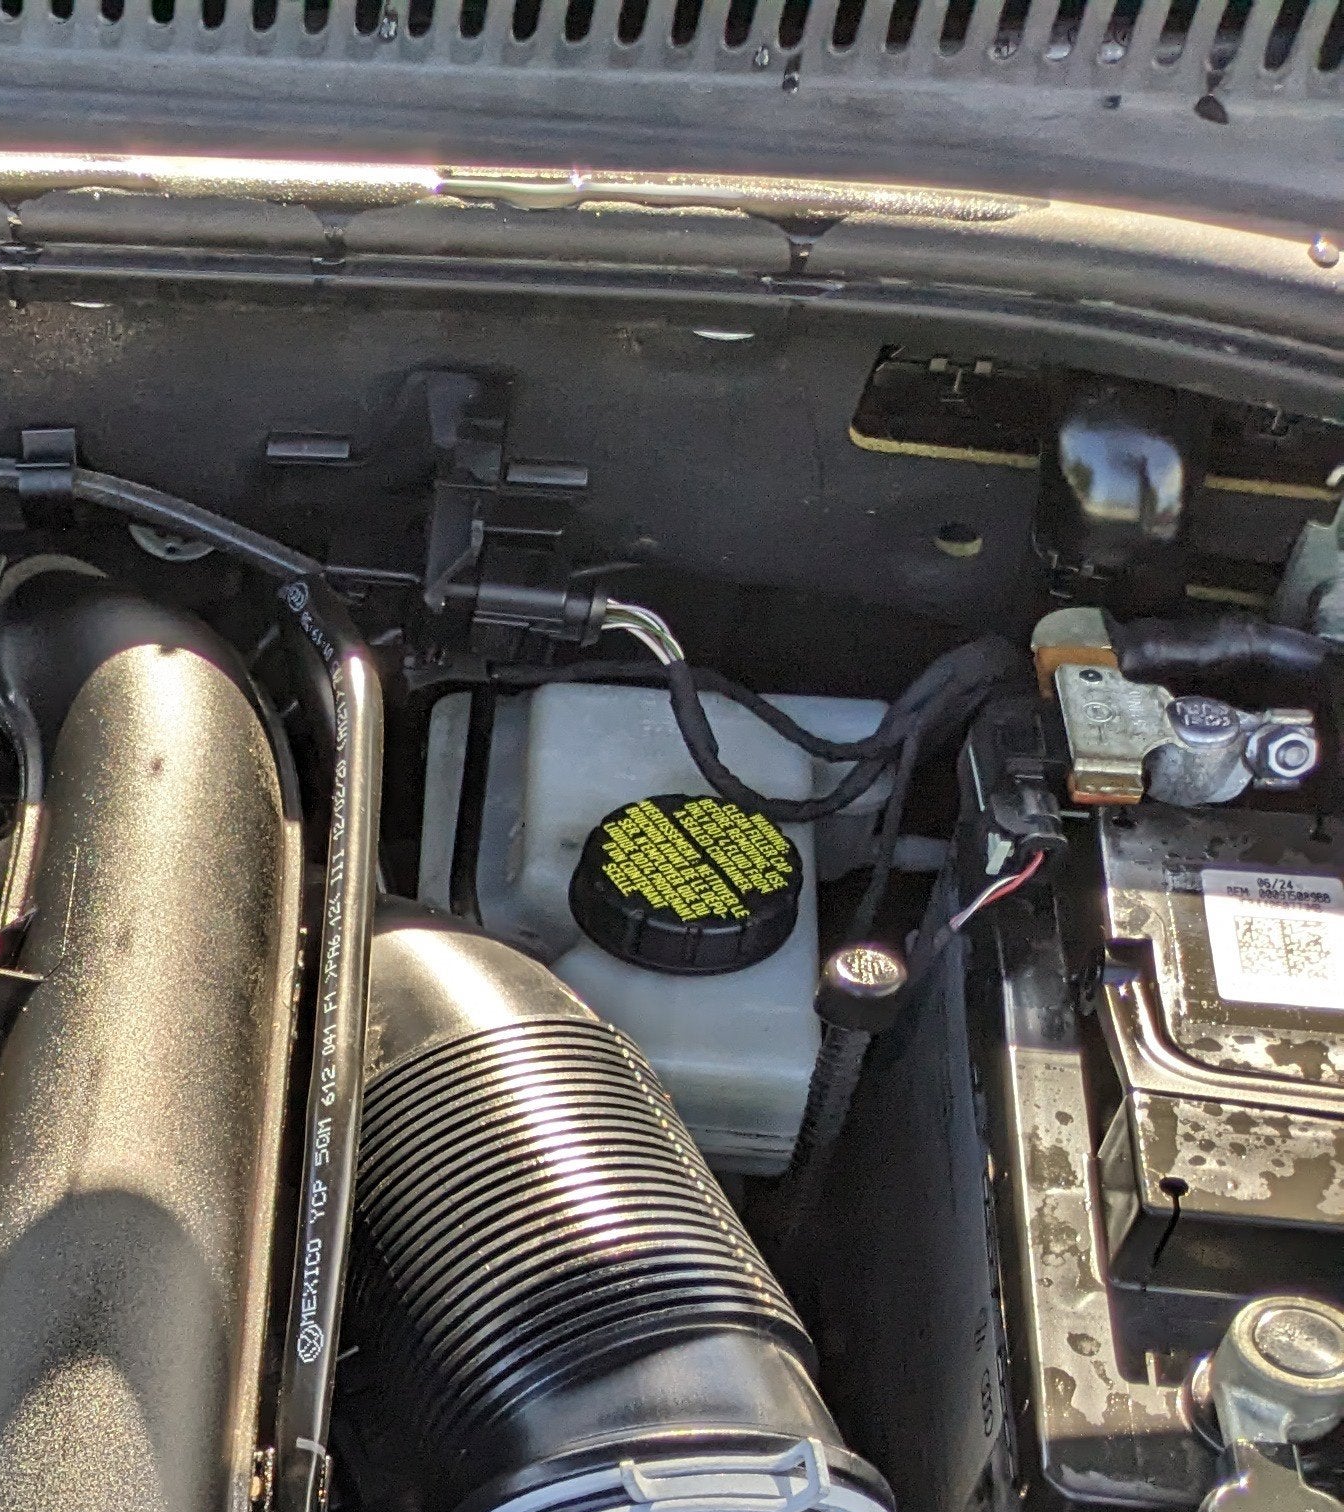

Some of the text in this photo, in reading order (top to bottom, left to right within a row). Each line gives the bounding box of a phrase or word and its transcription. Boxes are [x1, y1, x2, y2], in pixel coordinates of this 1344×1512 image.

[625, 806, 661, 844] BOUCHON
[657, 840, 689, 870] AVANT
[682, 867, 698, 881] DE
[690, 879, 708, 893] LE
[679, 816, 714, 846] SEALED
[684, 802, 707, 825] ONLY
[702, 823, 725, 842] DOT
[722, 844, 751, 869] FLUID
[746, 864, 773, 895] FROM
[698, 798, 734, 831] BEFORE
[765, 870, 788, 888] USE
[722, 804, 793, 874] CLEAN FILLER CAP
[749, 813, 789, 854] WARNING:
[603, 822, 638, 853] LIQUIDE
[649, 869, 698, 921] PROVENANT
[619, 861, 668, 908] CONTENANT
[695, 863, 740, 906] NETTOYER
[731, 904, 750, 920] LE
[677, 883, 700, 904] QUE
[690, 902, 710, 916] DU
[321, 989, 340, 1015] F1
[320, 1021, 340, 1057] 041
[316, 1065, 339, 1107] 612
[306, 1178, 330, 1225] YCP
[296, 1235, 327, 1325] MEXICO
